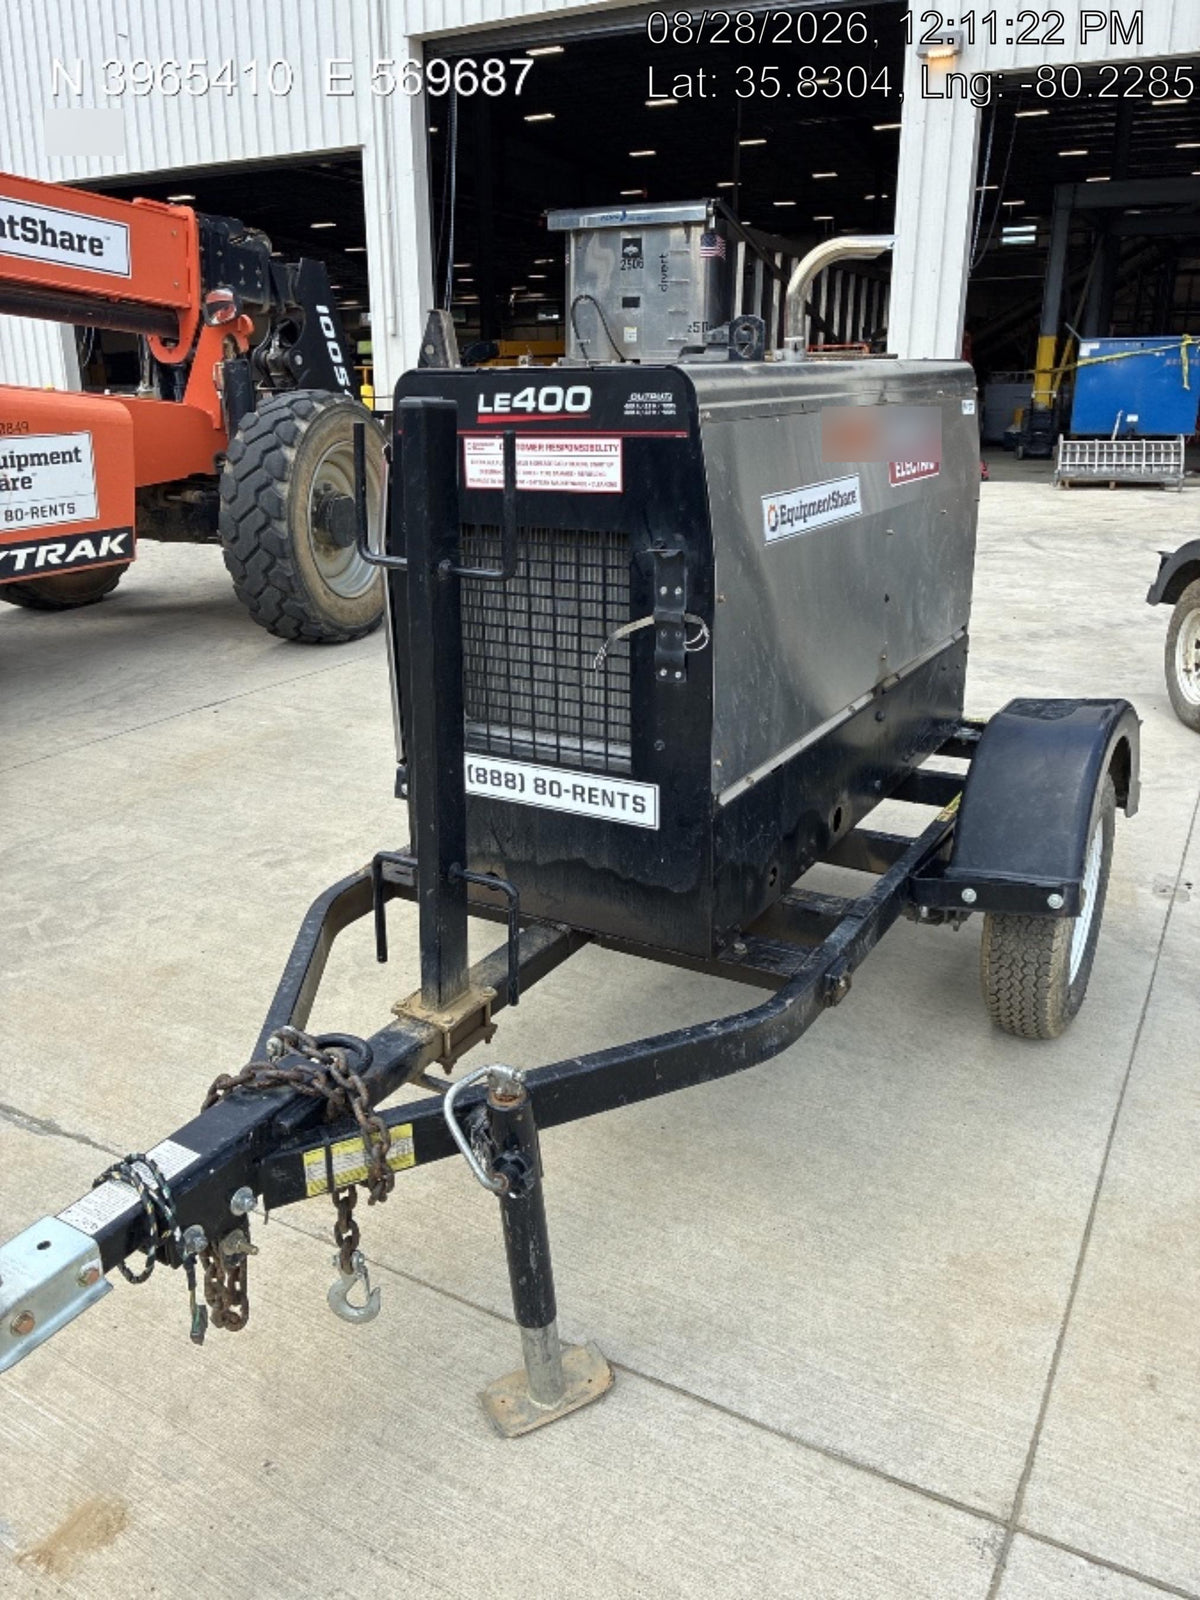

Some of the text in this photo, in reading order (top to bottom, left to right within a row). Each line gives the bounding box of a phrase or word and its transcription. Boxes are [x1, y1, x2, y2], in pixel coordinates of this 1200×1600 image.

[316, 304, 353, 400] 1005
[477, 385, 593, 413] LE400
[4, 502, 76, 522] 80-RENTS
[780, 489, 857, 526] EquipmentShare
[467, 764, 646, 813] (888) 80-RENTS
